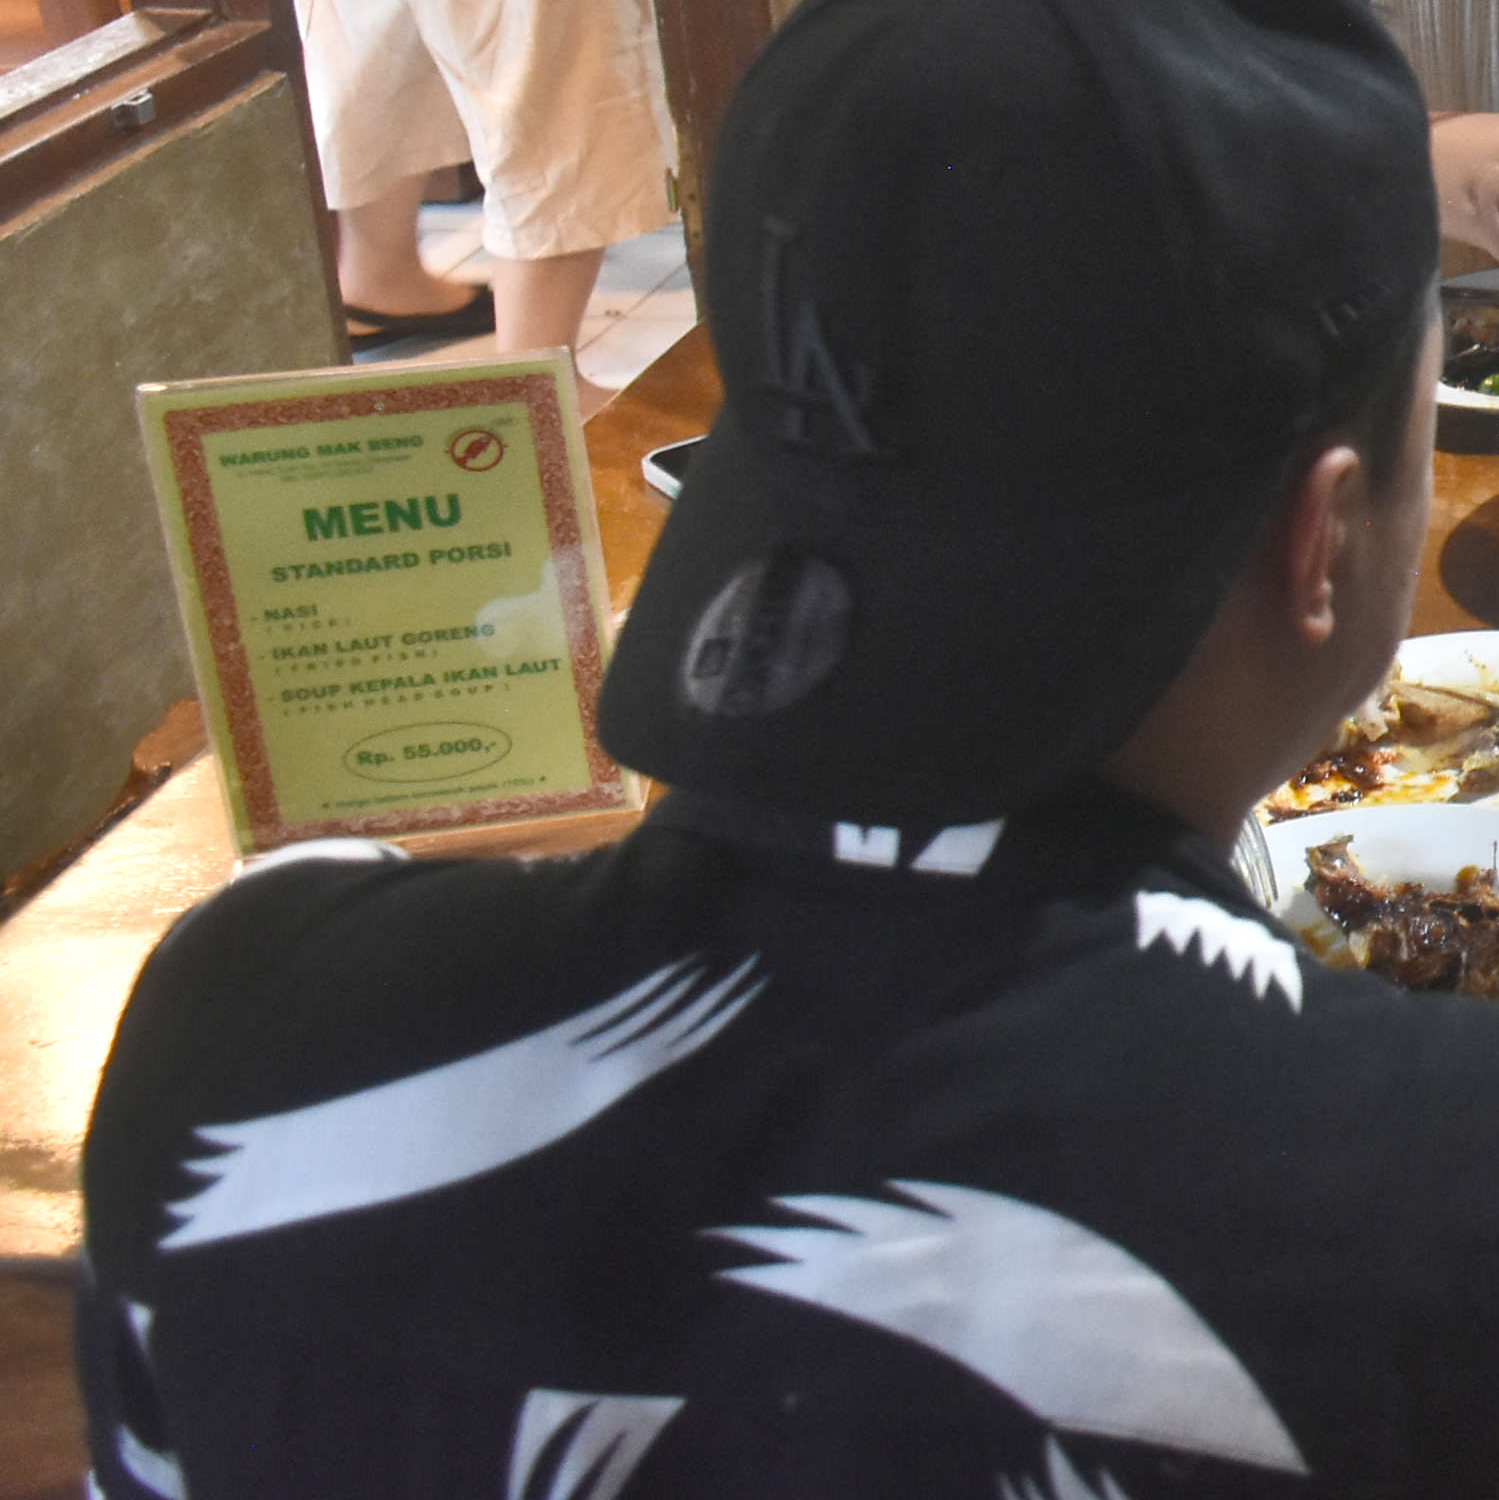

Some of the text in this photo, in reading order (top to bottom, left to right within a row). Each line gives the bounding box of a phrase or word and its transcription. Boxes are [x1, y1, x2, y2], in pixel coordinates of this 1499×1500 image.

[218, 435, 424, 467] WARUNG MAK BENG
[303, 493, 463, 541] MENU
[271, 541, 512, 583] STANDARD PORSI
[264, 604, 318, 621] NASI
[273, 623, 496, 660] IKAN LAUT GORENG
[281, 659, 562, 702] SOUP KEPALA IKAN LAUT
[356, 750, 395, 768] Rp.
